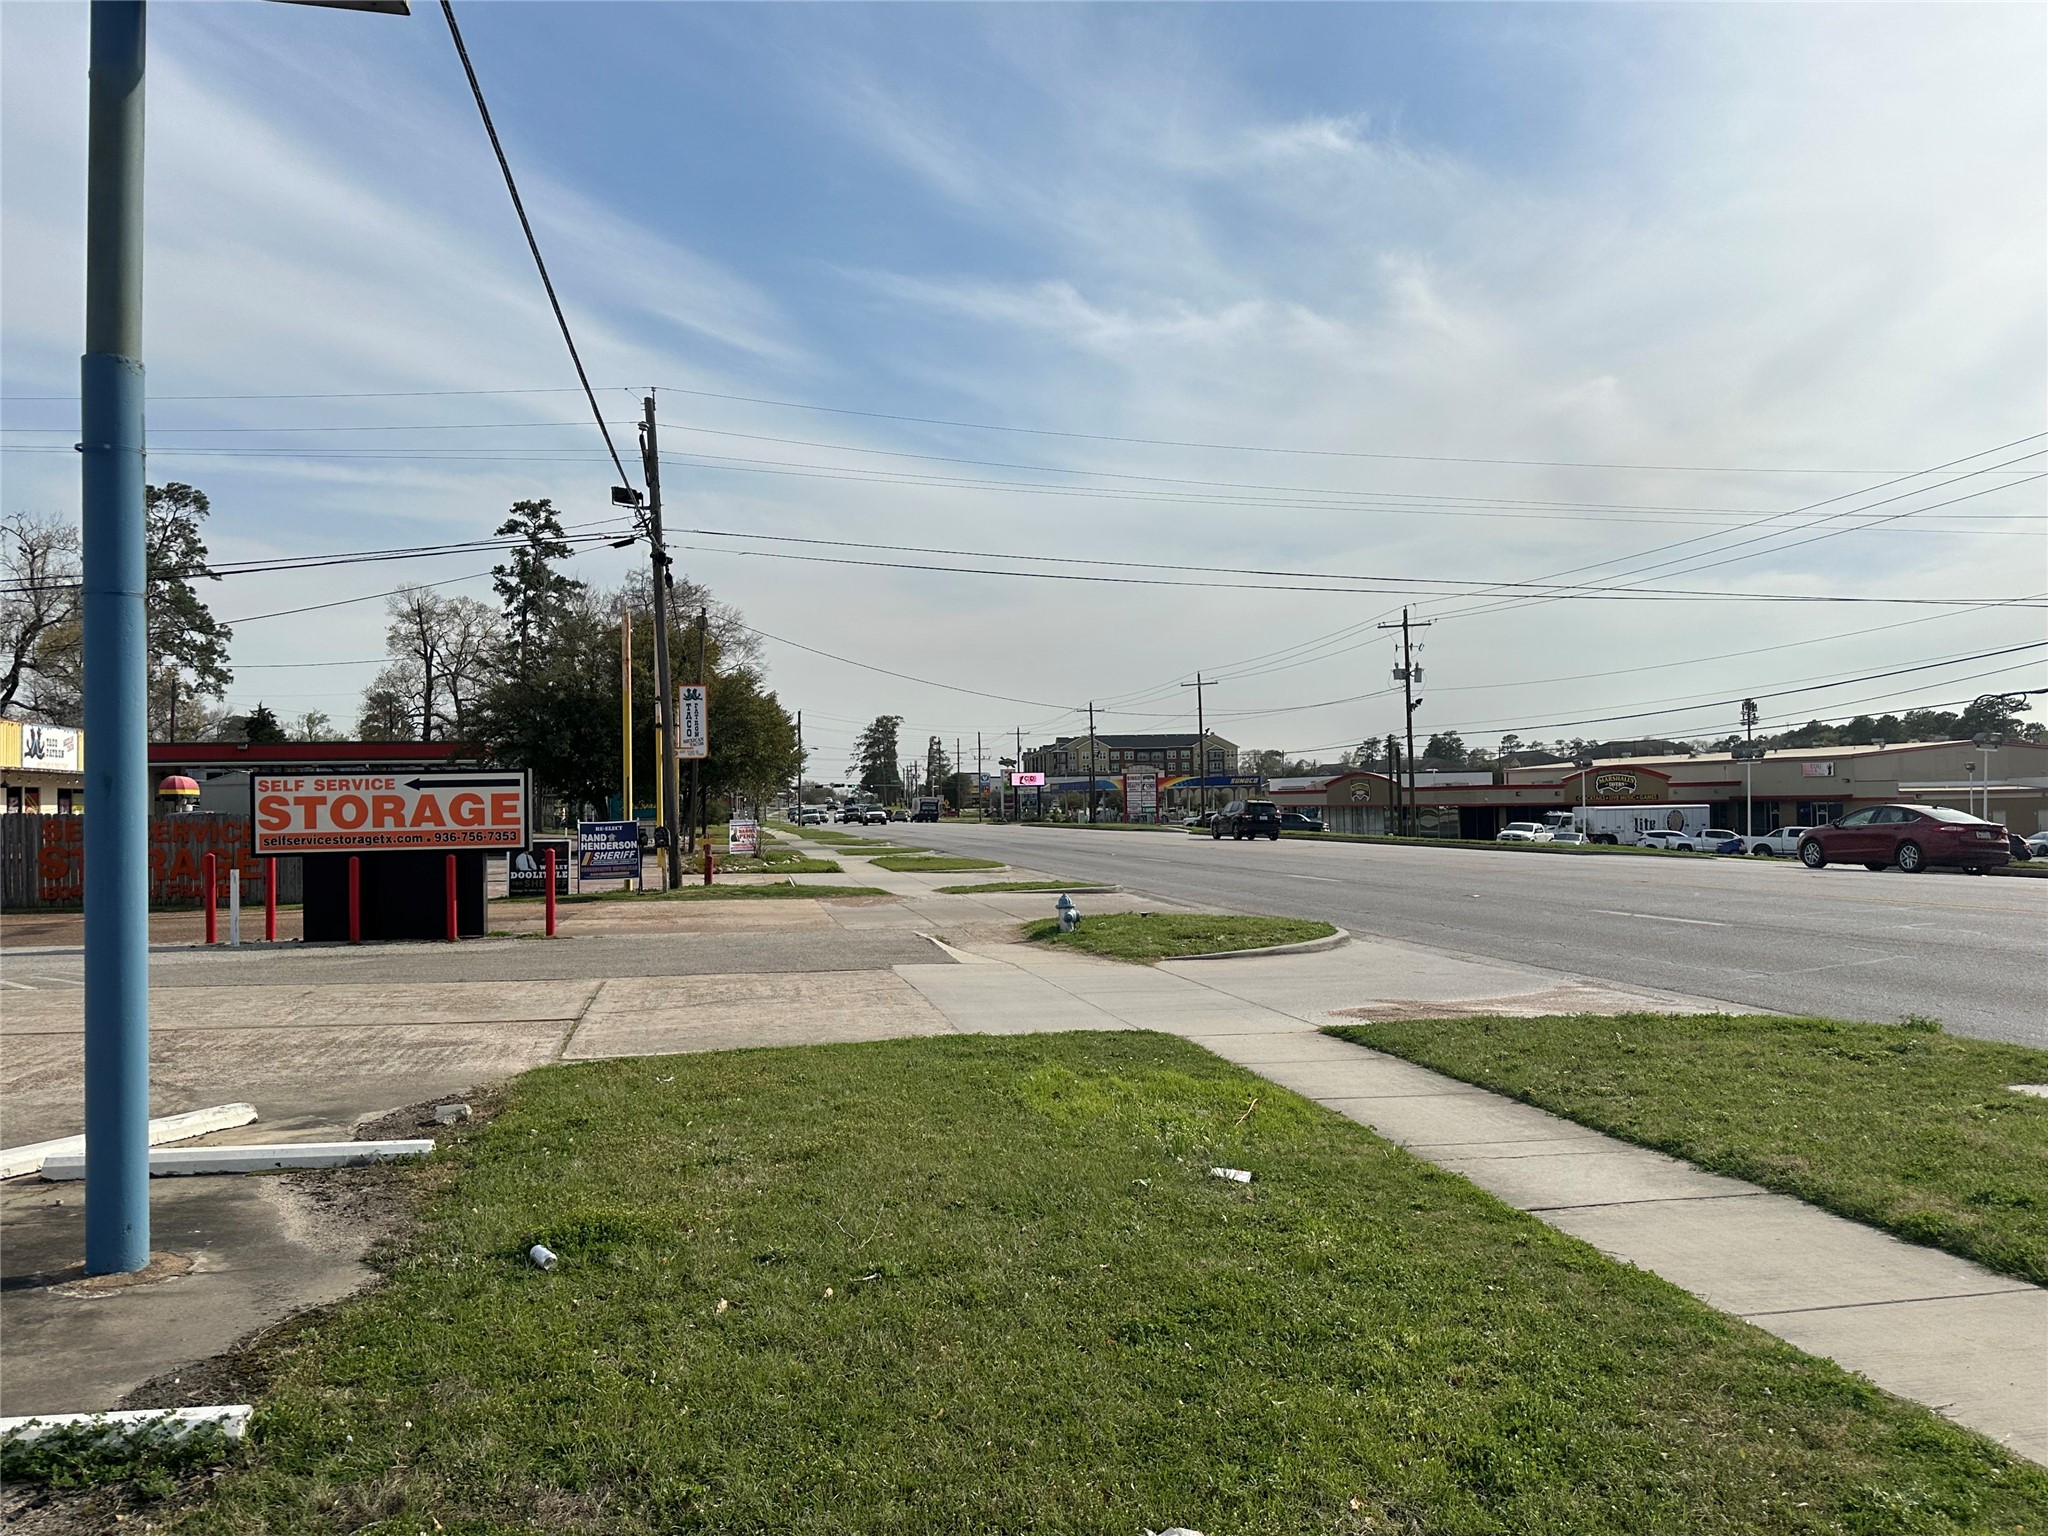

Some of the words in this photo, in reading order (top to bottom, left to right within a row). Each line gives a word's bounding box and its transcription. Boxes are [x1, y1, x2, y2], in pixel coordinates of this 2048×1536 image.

[258, 780, 305, 792] SELF
[314, 778, 396, 791] SERVICE
[258, 793, 520, 831] STORAGE
[43, 820, 84, 842] SE
[263, 834, 423, 846] selfservicestoragetx.com
[434, 831, 517, 843] 936-756-7353
[581, 833, 607, 842] RAND
[580, 840, 637, 850] HENDERSON
[592, 851, 636, 860] SHERIFF
[510, 871, 568, 879] DOOLITLE
